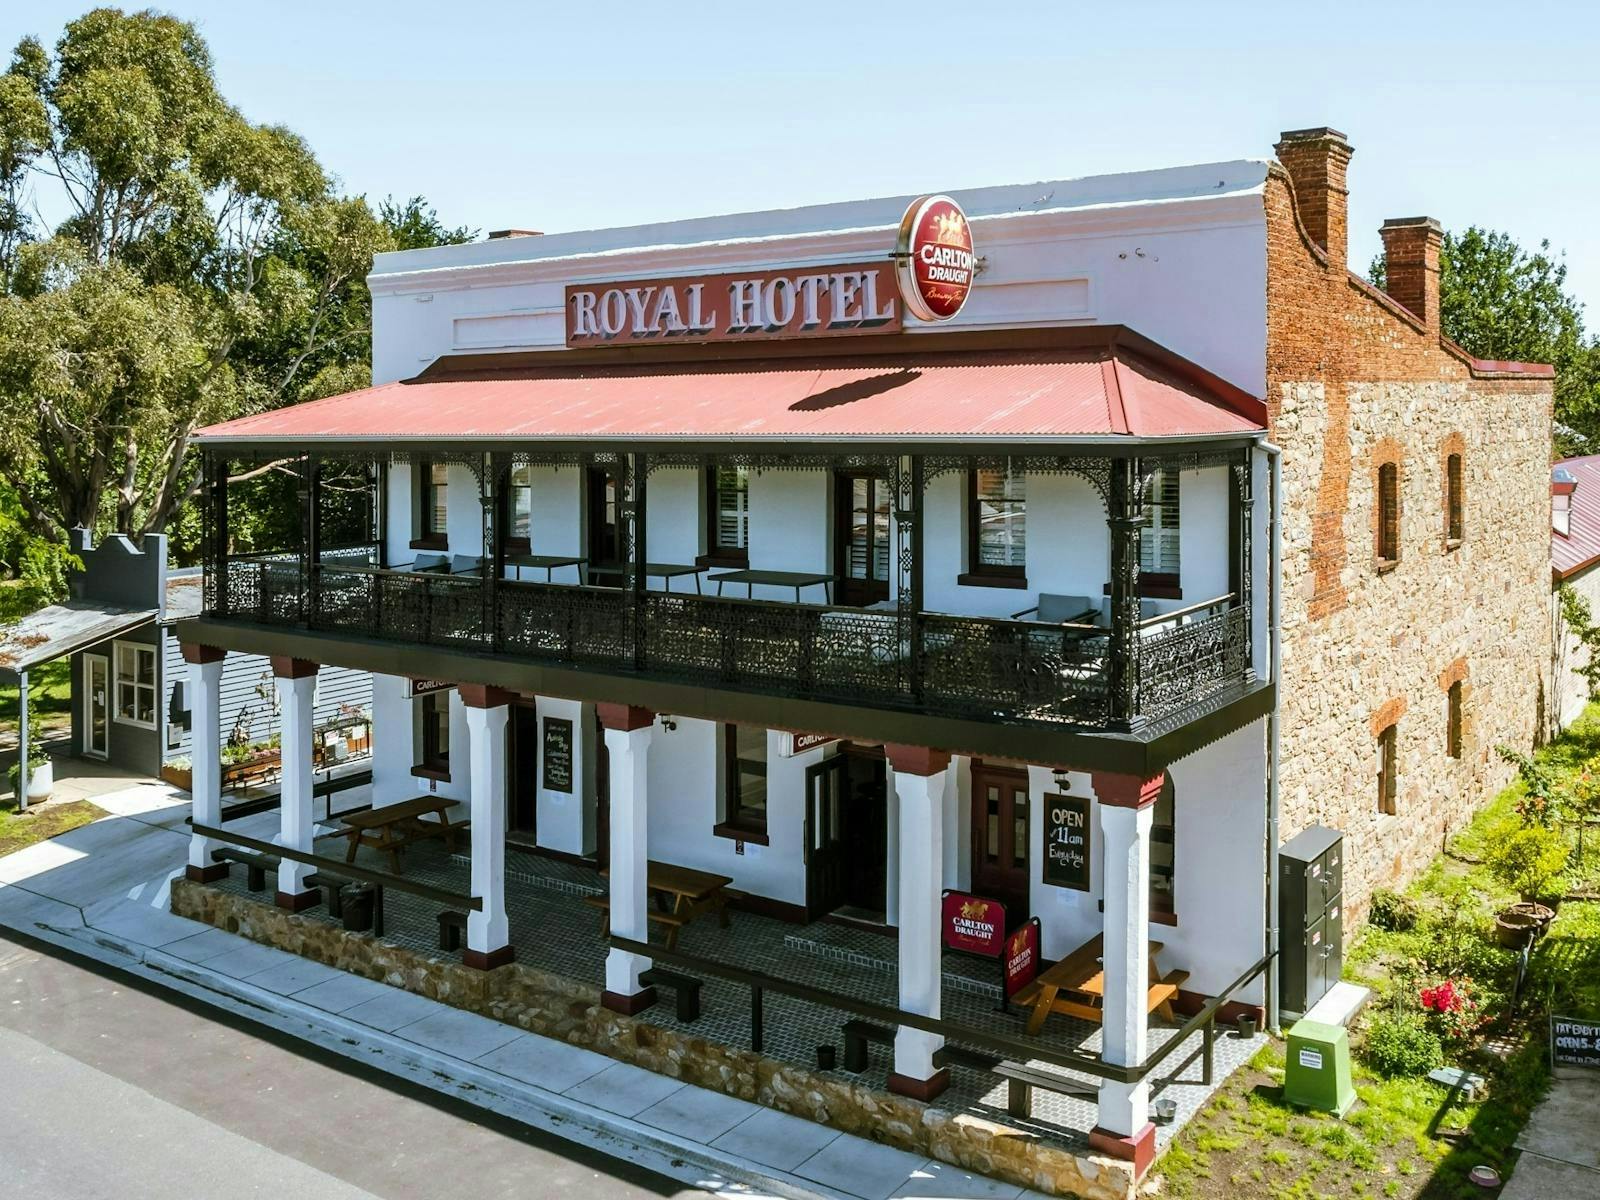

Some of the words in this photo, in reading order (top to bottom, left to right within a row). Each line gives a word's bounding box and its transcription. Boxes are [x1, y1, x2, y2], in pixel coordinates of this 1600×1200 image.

[920, 244, 972, 270] CARLTON
[928, 266, 969, 284] DRAUGHT
[570, 284, 717, 339] ROYAL
[727, 270, 896, 334] HOTEL
[797, 734, 828, 747] CARLTO
[1051, 808, 1084, 828] OPEN
[1056, 826, 1083, 845] 11am
[952, 916, 994, 933] CARLTON
[954, 925, 993, 940] DRAUGHT
[1008, 947, 1032, 969] CARLTON
[1009, 957, 1031, 977] DRAUGHT
